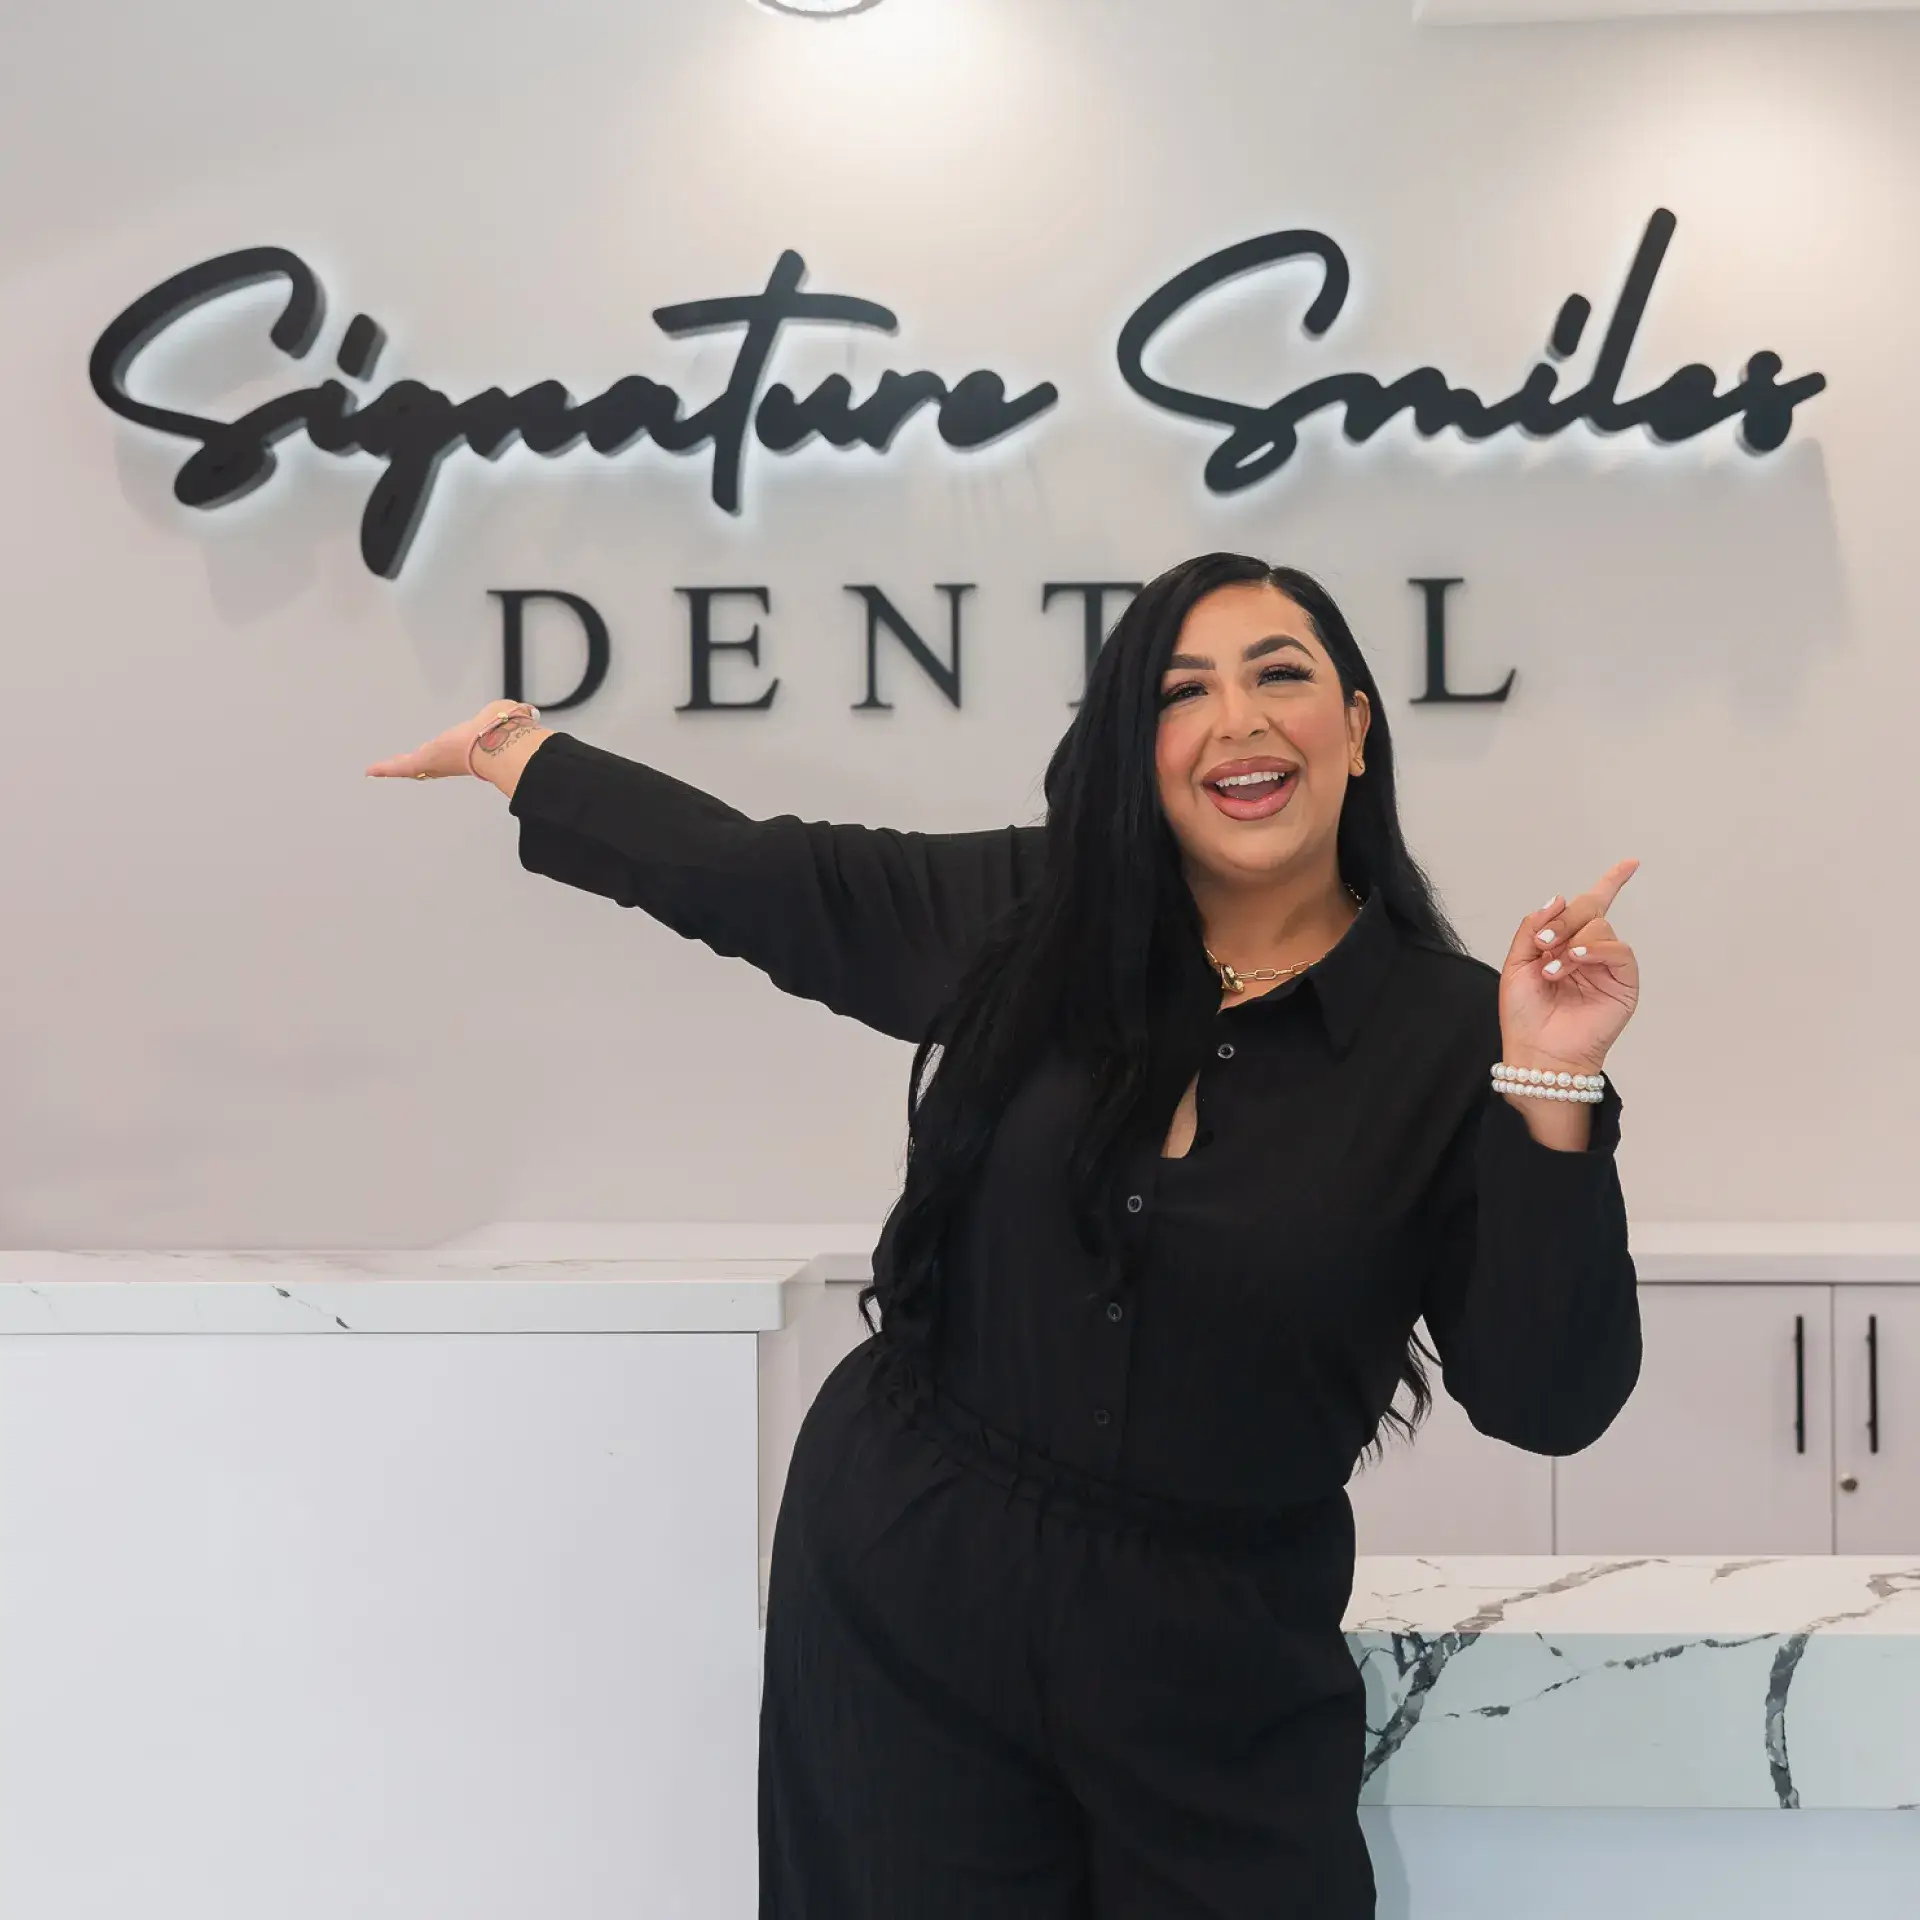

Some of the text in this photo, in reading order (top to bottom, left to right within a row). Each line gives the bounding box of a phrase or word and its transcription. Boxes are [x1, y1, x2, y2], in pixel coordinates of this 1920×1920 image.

[89, 207, 1827, 579] Signature Smiles
[486, 576, 1518, 715] DENTL
